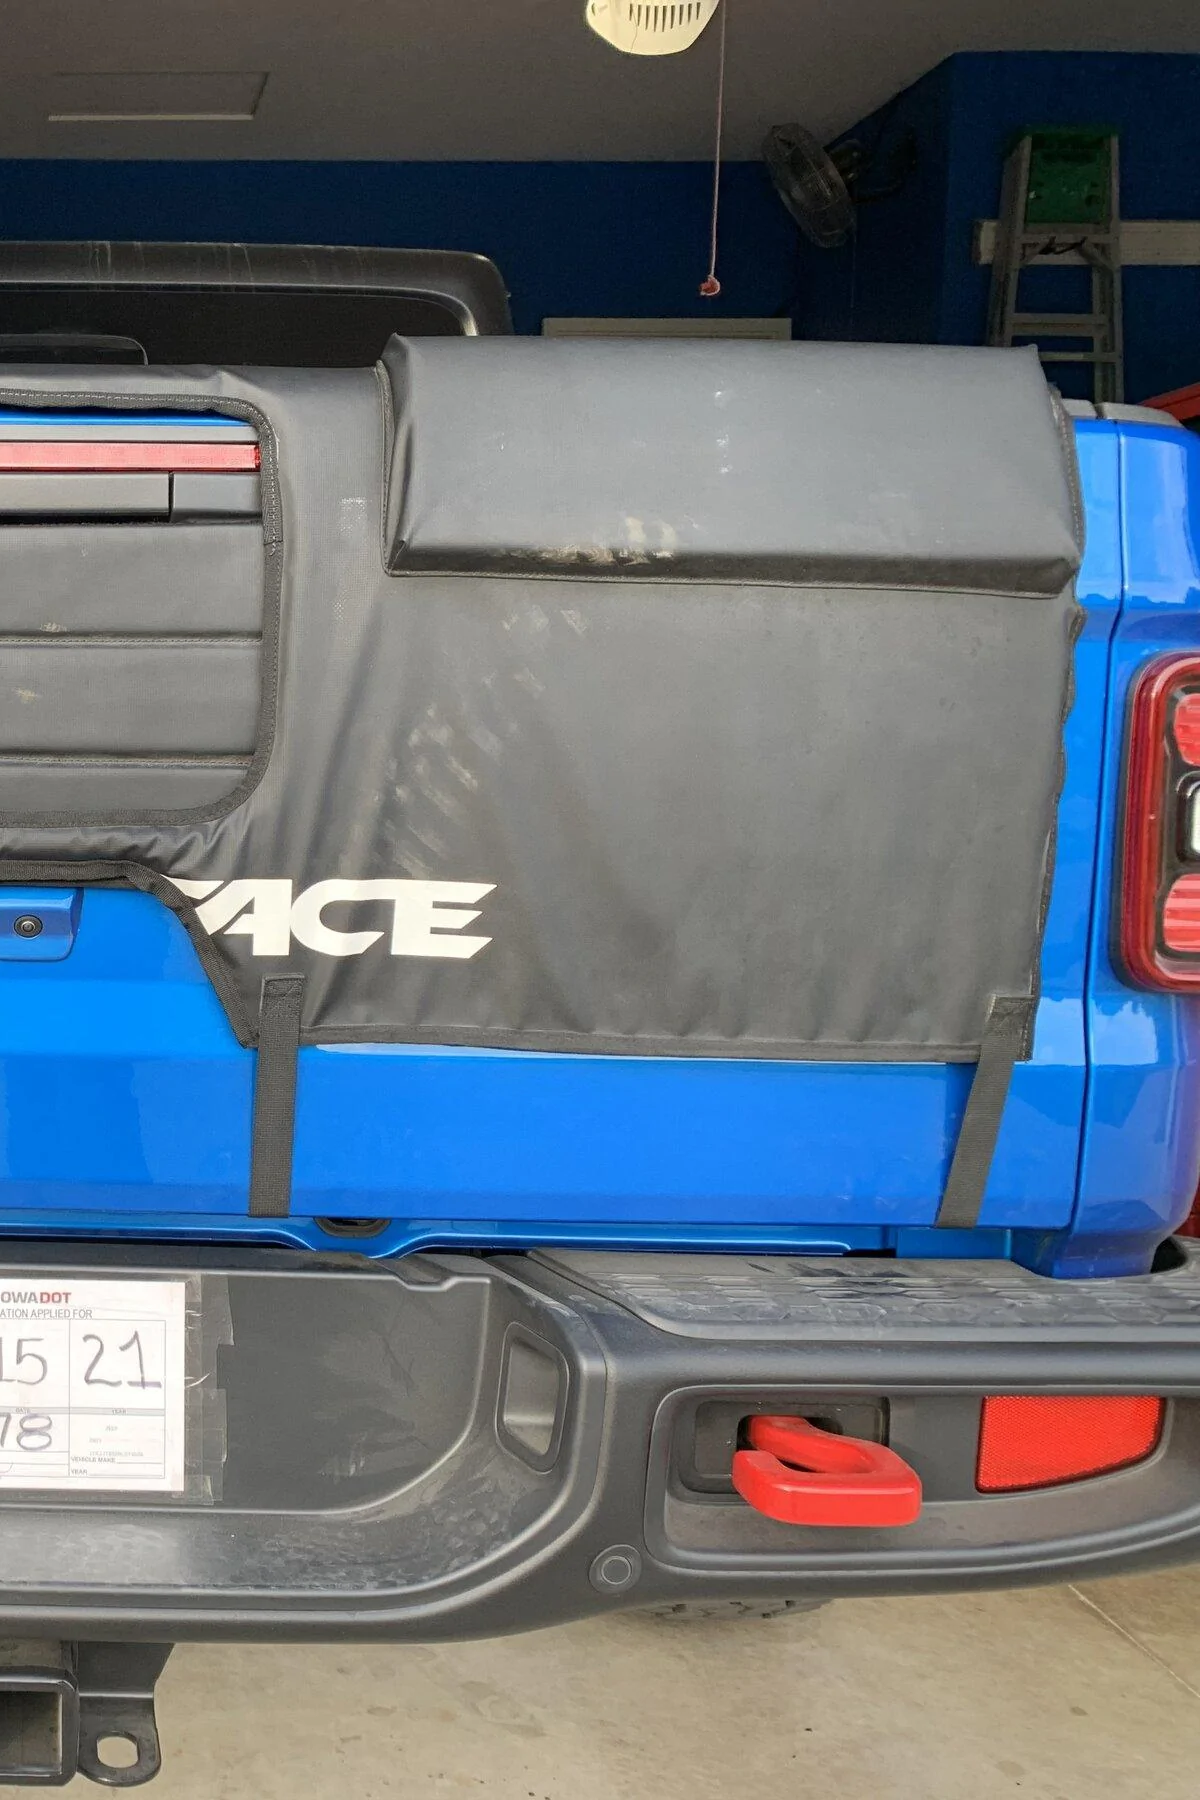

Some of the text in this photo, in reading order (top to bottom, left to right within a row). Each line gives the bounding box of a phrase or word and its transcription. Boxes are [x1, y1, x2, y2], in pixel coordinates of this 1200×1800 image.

[30, 1308, 71, 1319] APPLIED
[72, 1309, 93, 1319] FOR
[82, 1330, 162, 1389] 21
[70, 1468, 88, 1476] YEAR
